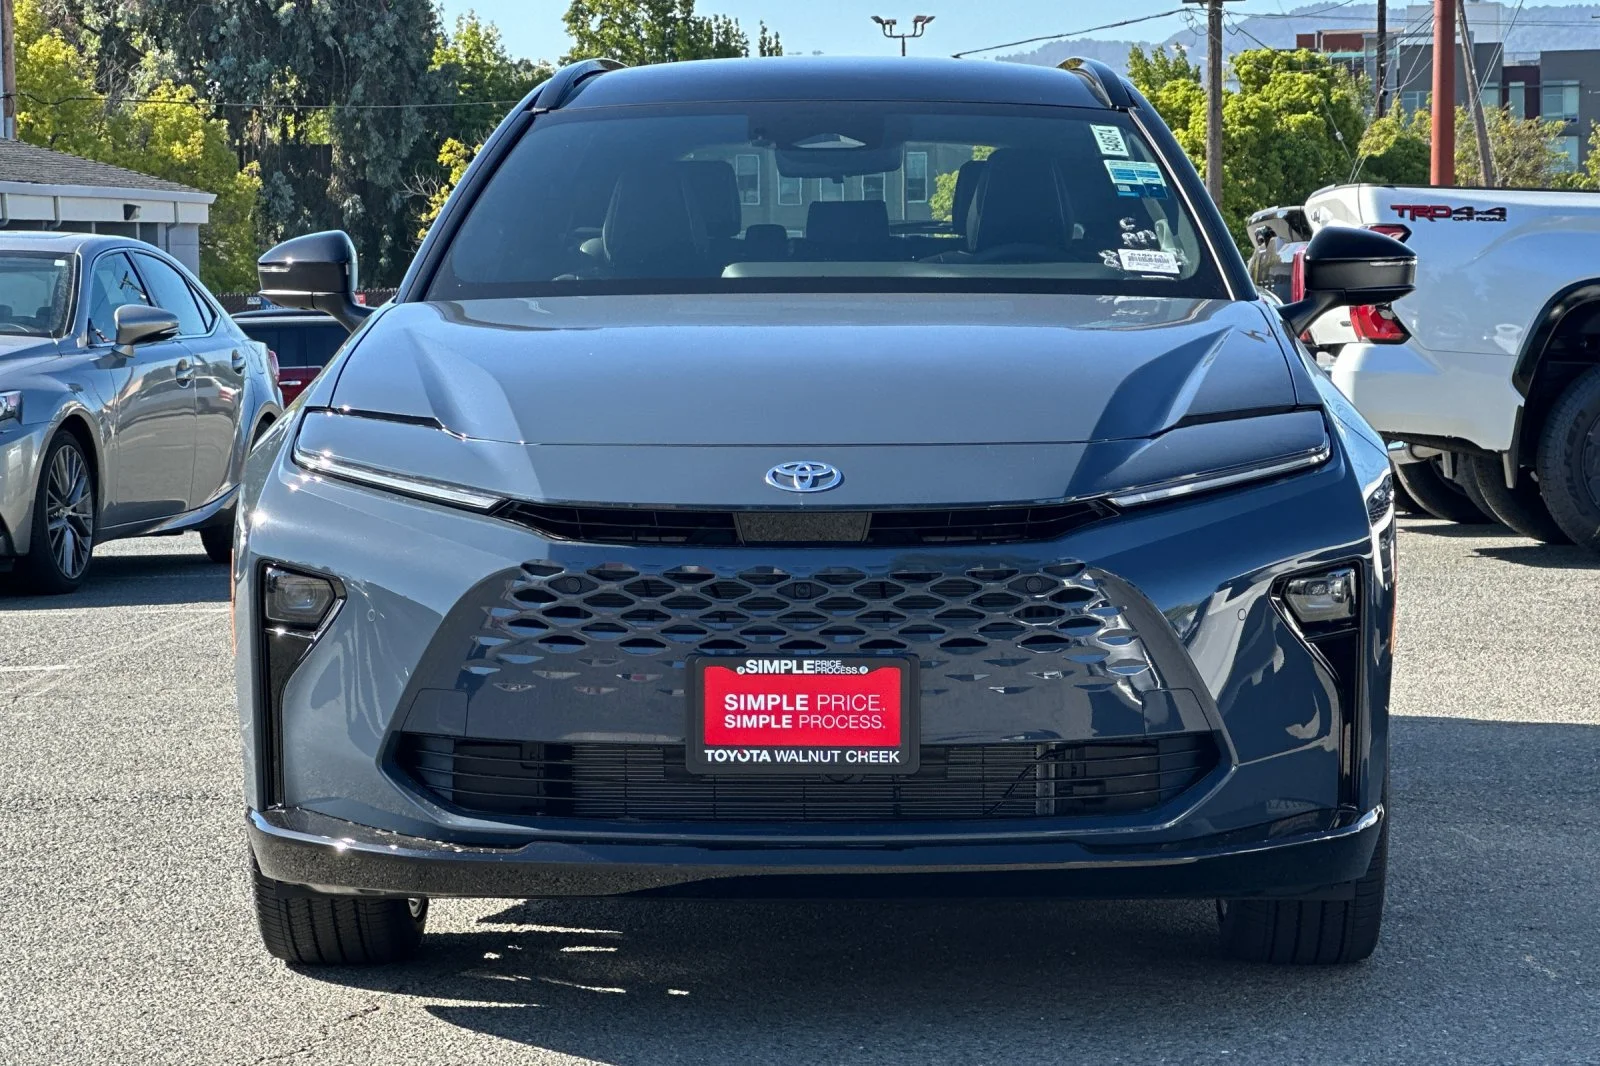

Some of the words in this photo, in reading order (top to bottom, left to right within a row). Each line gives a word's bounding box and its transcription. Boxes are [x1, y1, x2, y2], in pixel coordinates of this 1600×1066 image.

[1390, 205, 1453, 222] TRD
[745, 659, 815, 674] SIMPLE
[724, 694, 809, 711] SIMPLE
[817, 694, 886, 711] PRICE.
[724, 714, 793, 729] SIMPLE
[799, 714, 886, 729] PROCESS.
[704, 749, 772, 763] TOYOTA
[774, 750, 841, 763] WALNUT
[845, 750, 900, 763] CREEK
